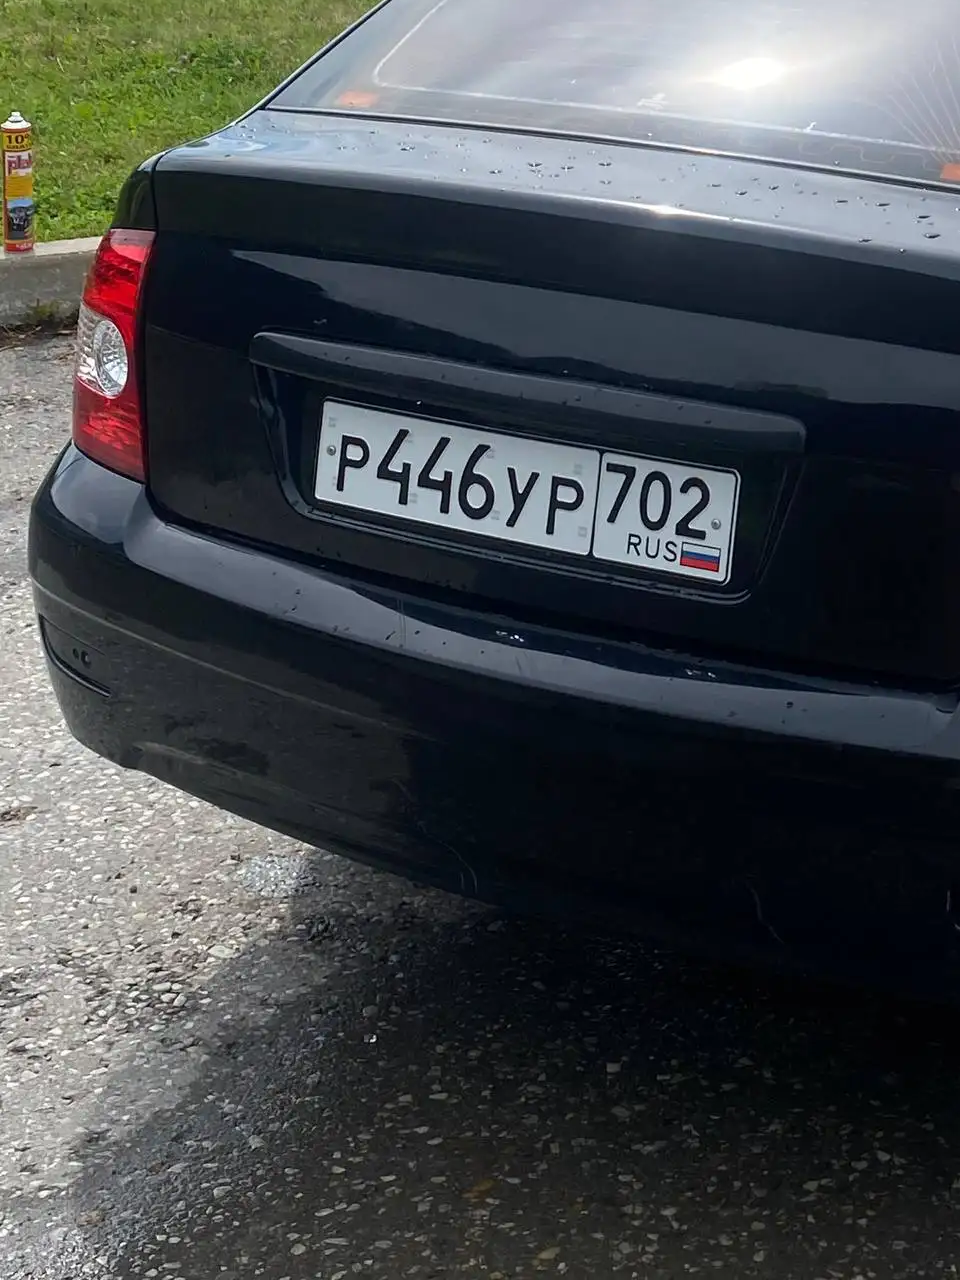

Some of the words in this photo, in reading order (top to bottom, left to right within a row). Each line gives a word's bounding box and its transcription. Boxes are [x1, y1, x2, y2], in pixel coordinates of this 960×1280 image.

[336, 428, 585, 535] Р446УР
[605, 462, 711, 540] 702
[626, 533, 678, 563] RUS
